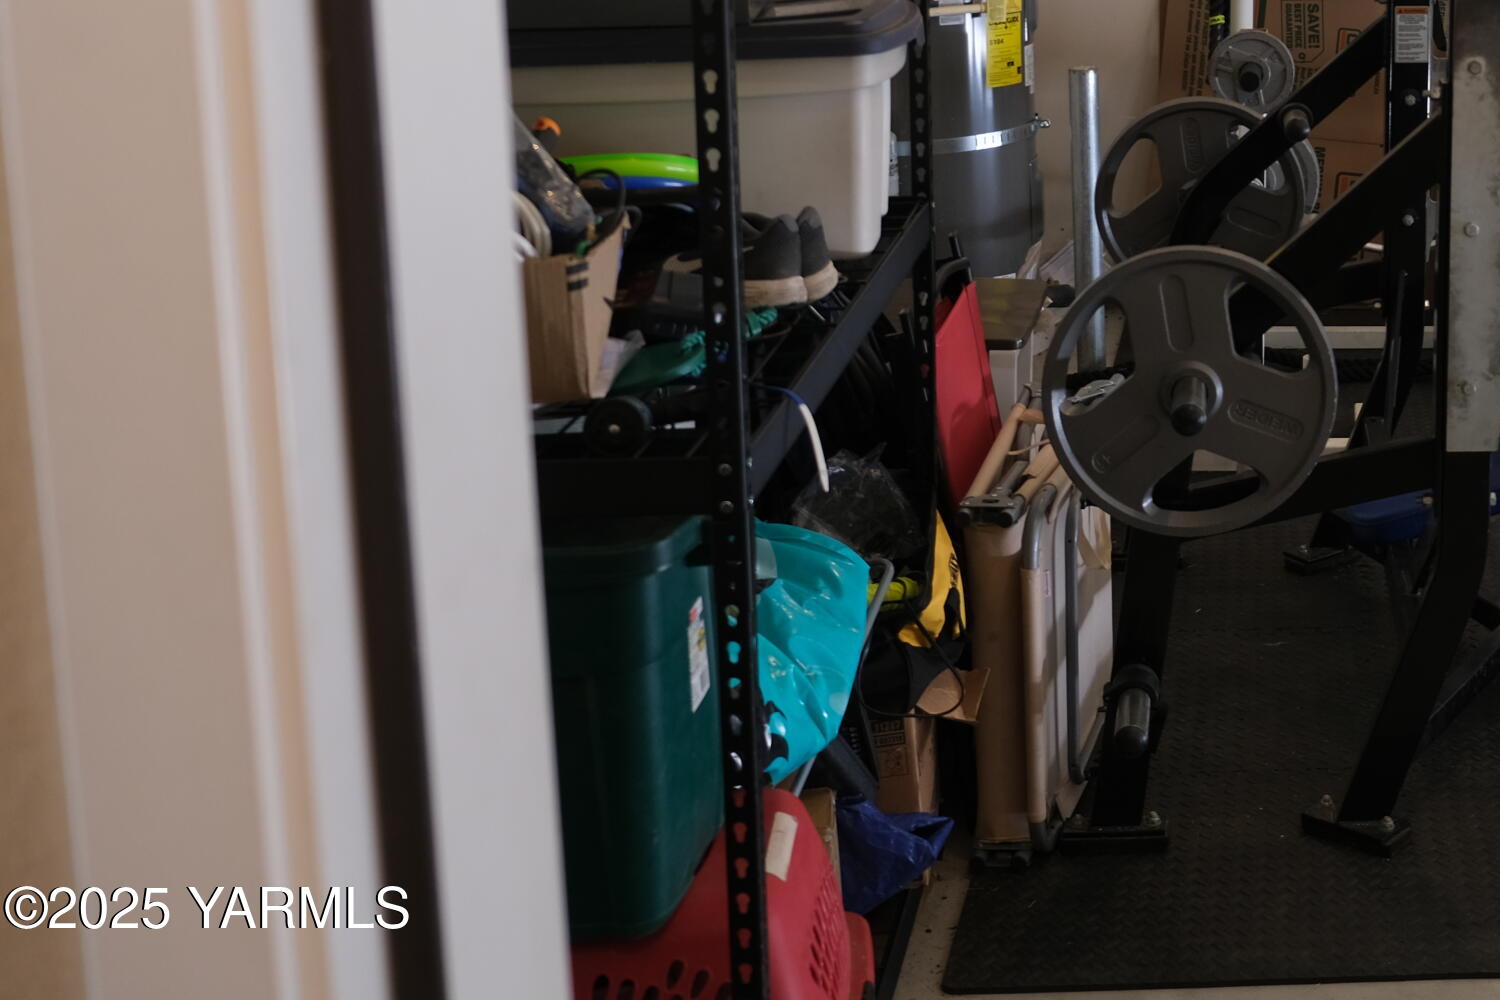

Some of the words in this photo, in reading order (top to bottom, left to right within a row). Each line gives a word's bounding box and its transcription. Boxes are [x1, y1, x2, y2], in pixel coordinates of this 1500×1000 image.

[1294, 3, 1302, 23] BEST
[1308, 3, 1320, 49] SAVE!
[1234, 401, 1300, 436] WEIDER
